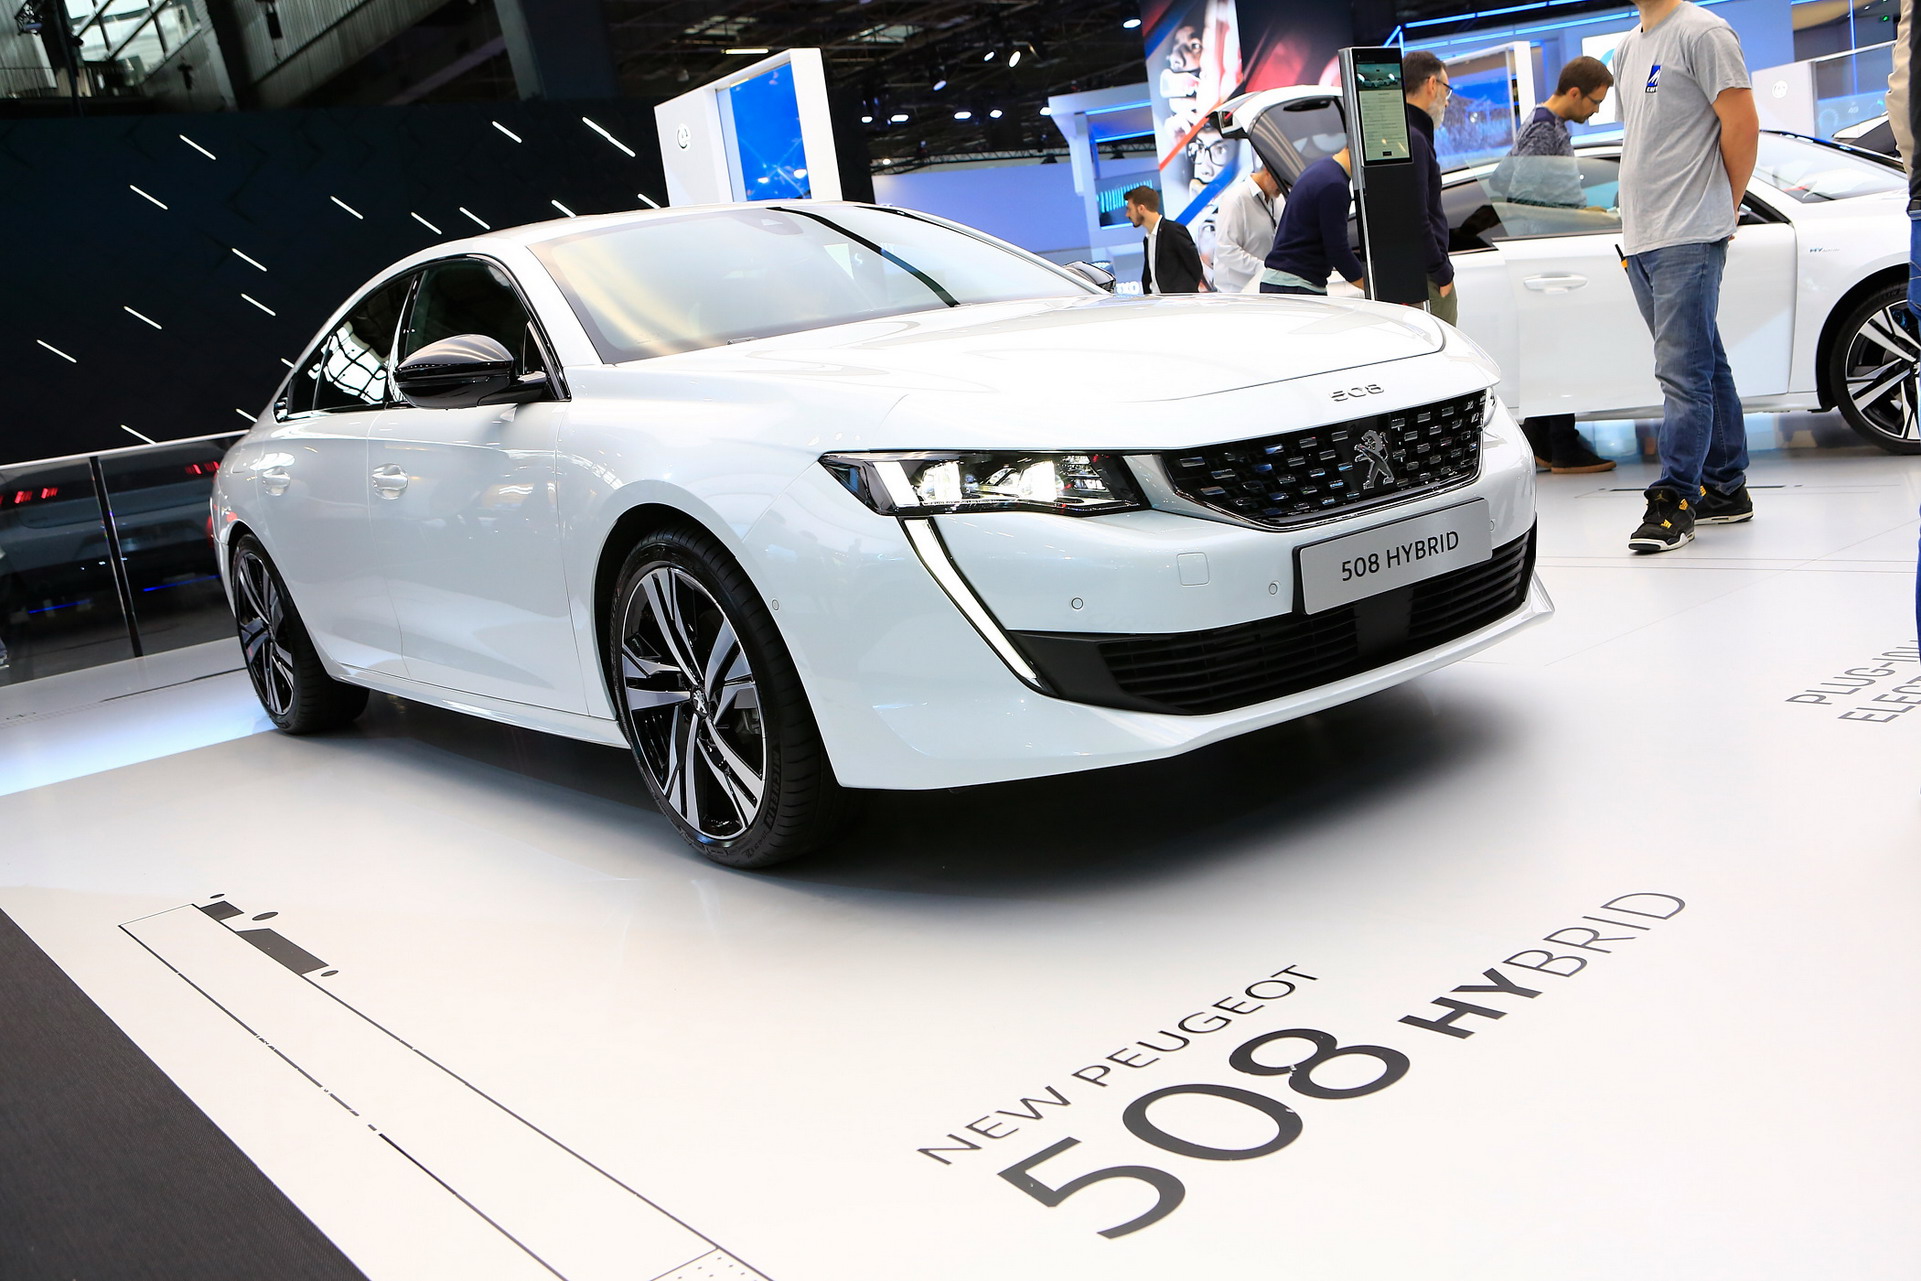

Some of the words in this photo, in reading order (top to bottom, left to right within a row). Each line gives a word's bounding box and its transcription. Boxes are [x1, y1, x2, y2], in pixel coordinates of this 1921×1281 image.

[1329, 383, 1385, 402] 508
[1341, 552, 1379, 582] 508
[1387, 530, 1459, 569] HYBRID
[1837, 675, 1921, 724] ELEC
[916, 1085, 1072, 1165] NEW
[1071, 964, 1319, 1088] PEUGEOT
[996, 1028, 1411, 1239] 508
[1397, 891, 1686, 1040] HYBRID
